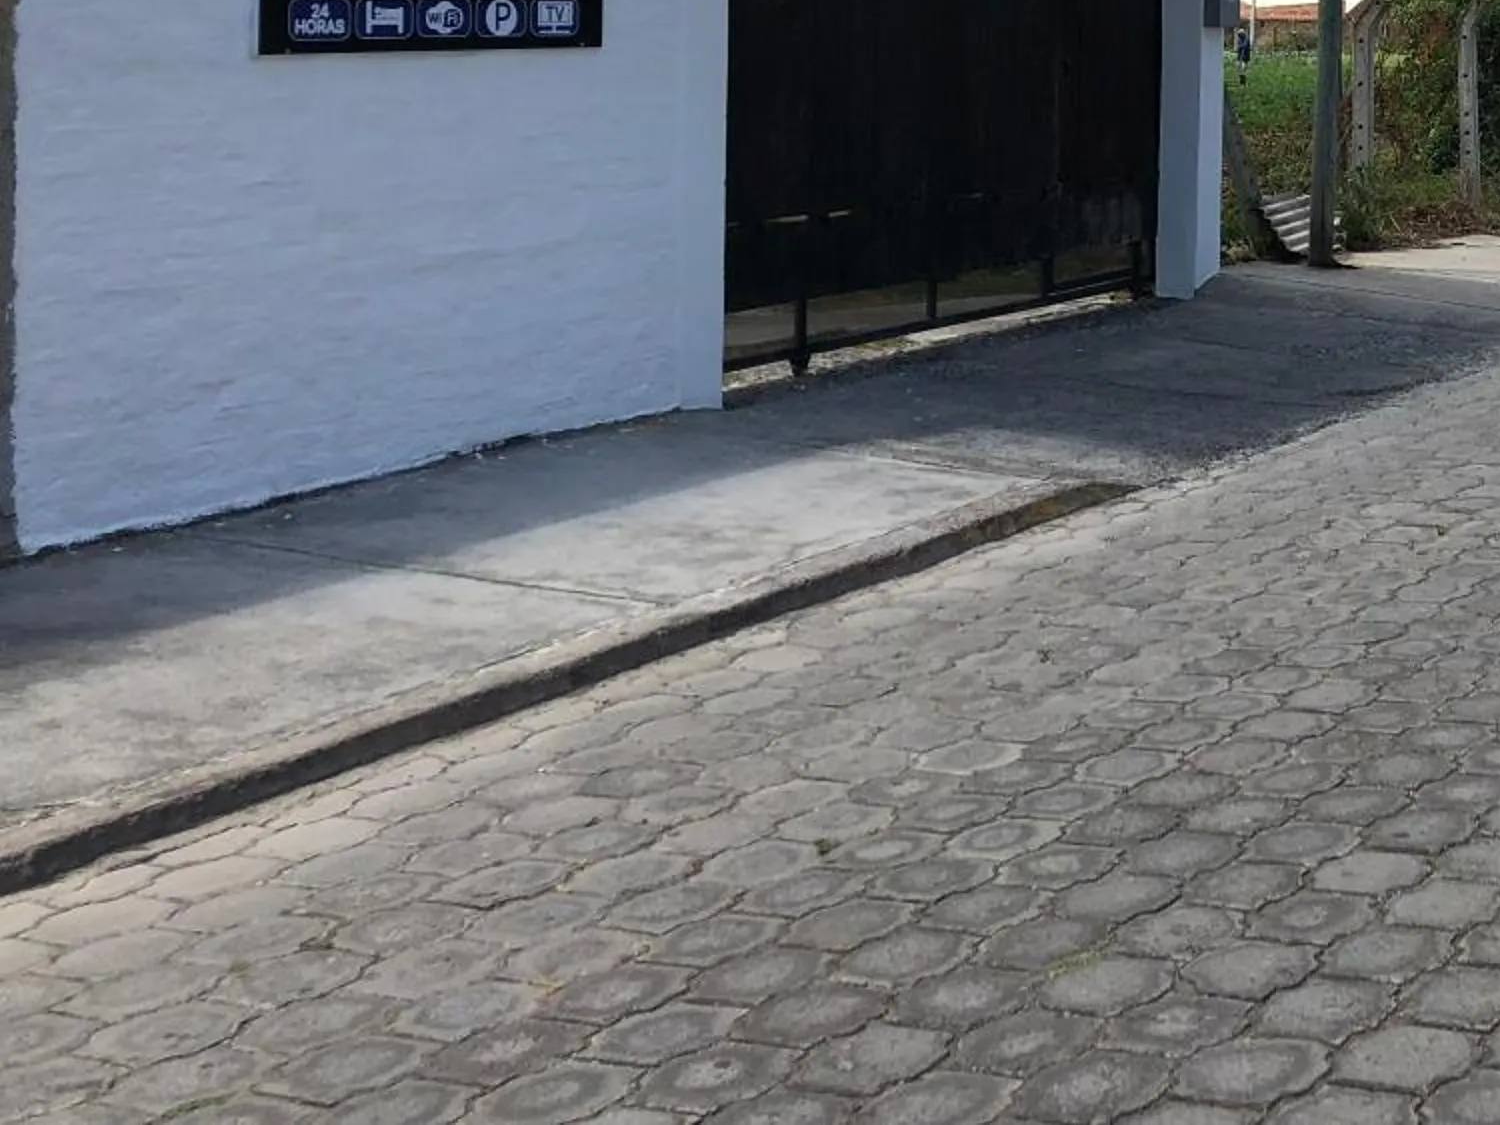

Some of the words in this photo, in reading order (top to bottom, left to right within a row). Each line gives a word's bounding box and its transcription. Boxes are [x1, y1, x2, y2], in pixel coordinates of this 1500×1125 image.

[311, 2, 330, 19] 24
[495, 2, 511, 32] P
[544, 5, 565, 22] TV
[294, 18, 346, 35] HORAS
